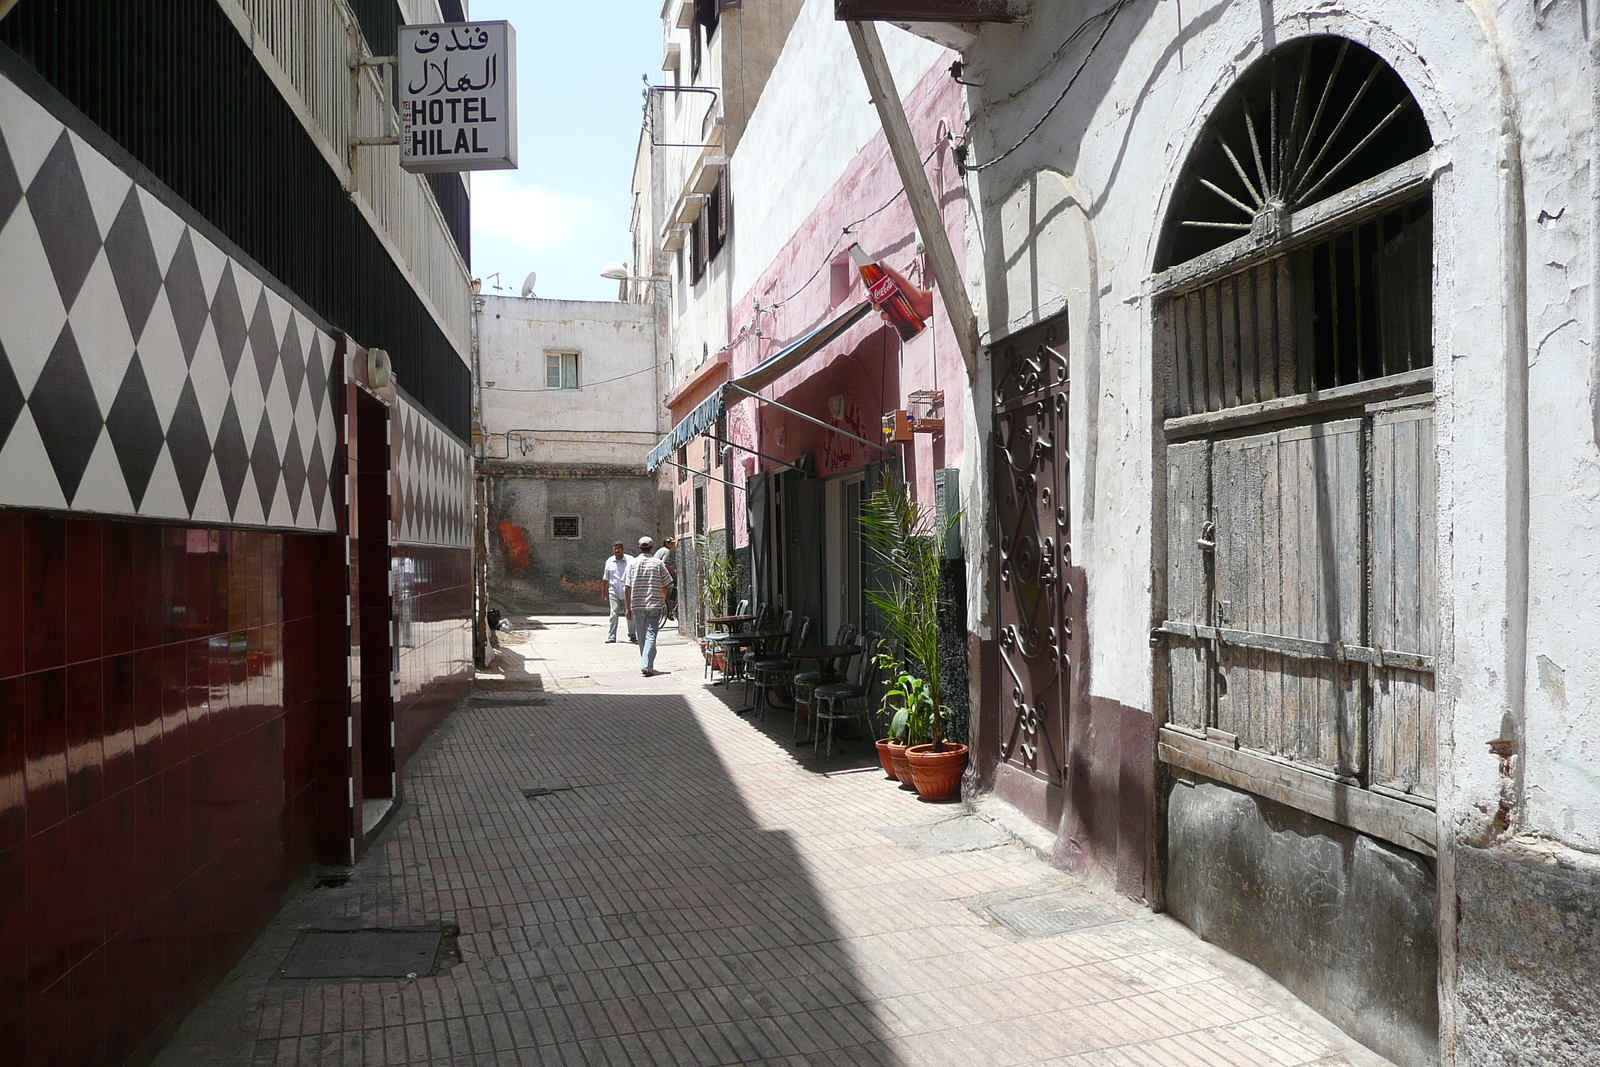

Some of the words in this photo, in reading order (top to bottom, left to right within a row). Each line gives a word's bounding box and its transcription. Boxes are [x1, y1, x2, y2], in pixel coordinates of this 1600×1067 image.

[414, 27, 489, 54] فندق
[408, 53, 497, 97] الهلال
[411, 97, 497, 126] HOTEL
[412, 127, 489, 156] HILAL
